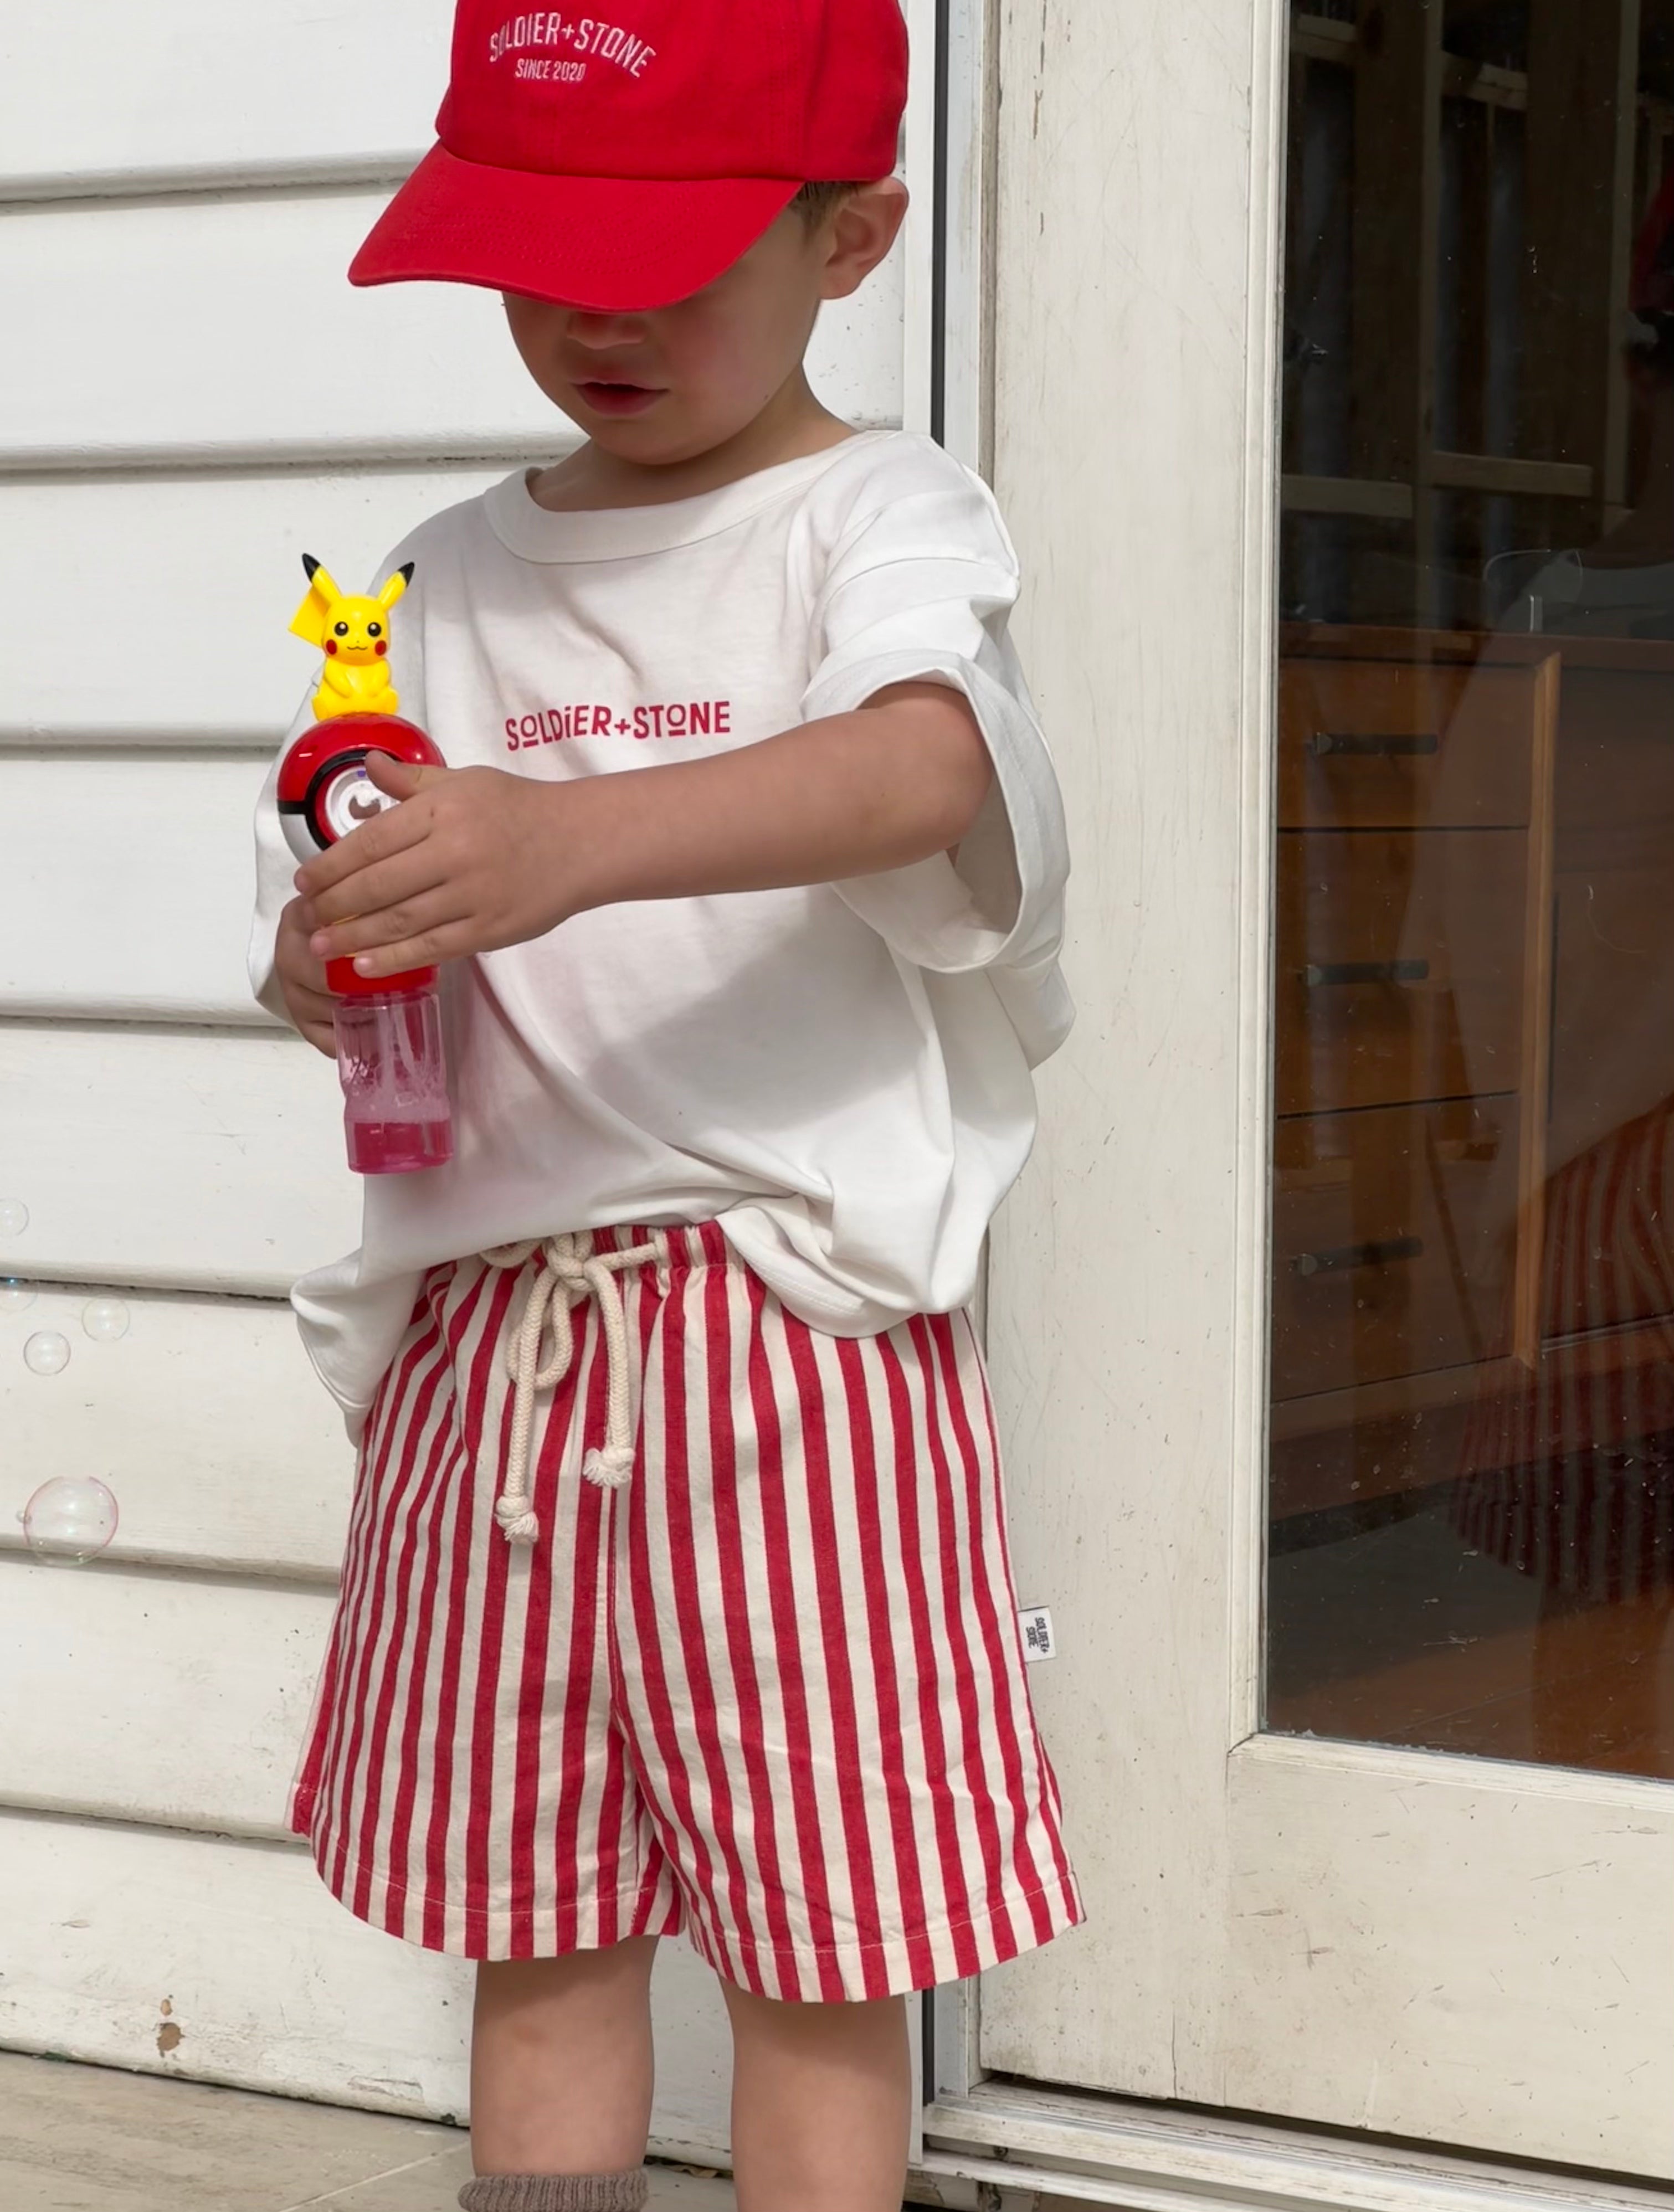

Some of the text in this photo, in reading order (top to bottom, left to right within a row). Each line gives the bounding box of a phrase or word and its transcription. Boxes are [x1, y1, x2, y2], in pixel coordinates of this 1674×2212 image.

[489, 12, 656, 78] SOLDIER+STONE
[515, 58, 586, 81] SINCE 2020
